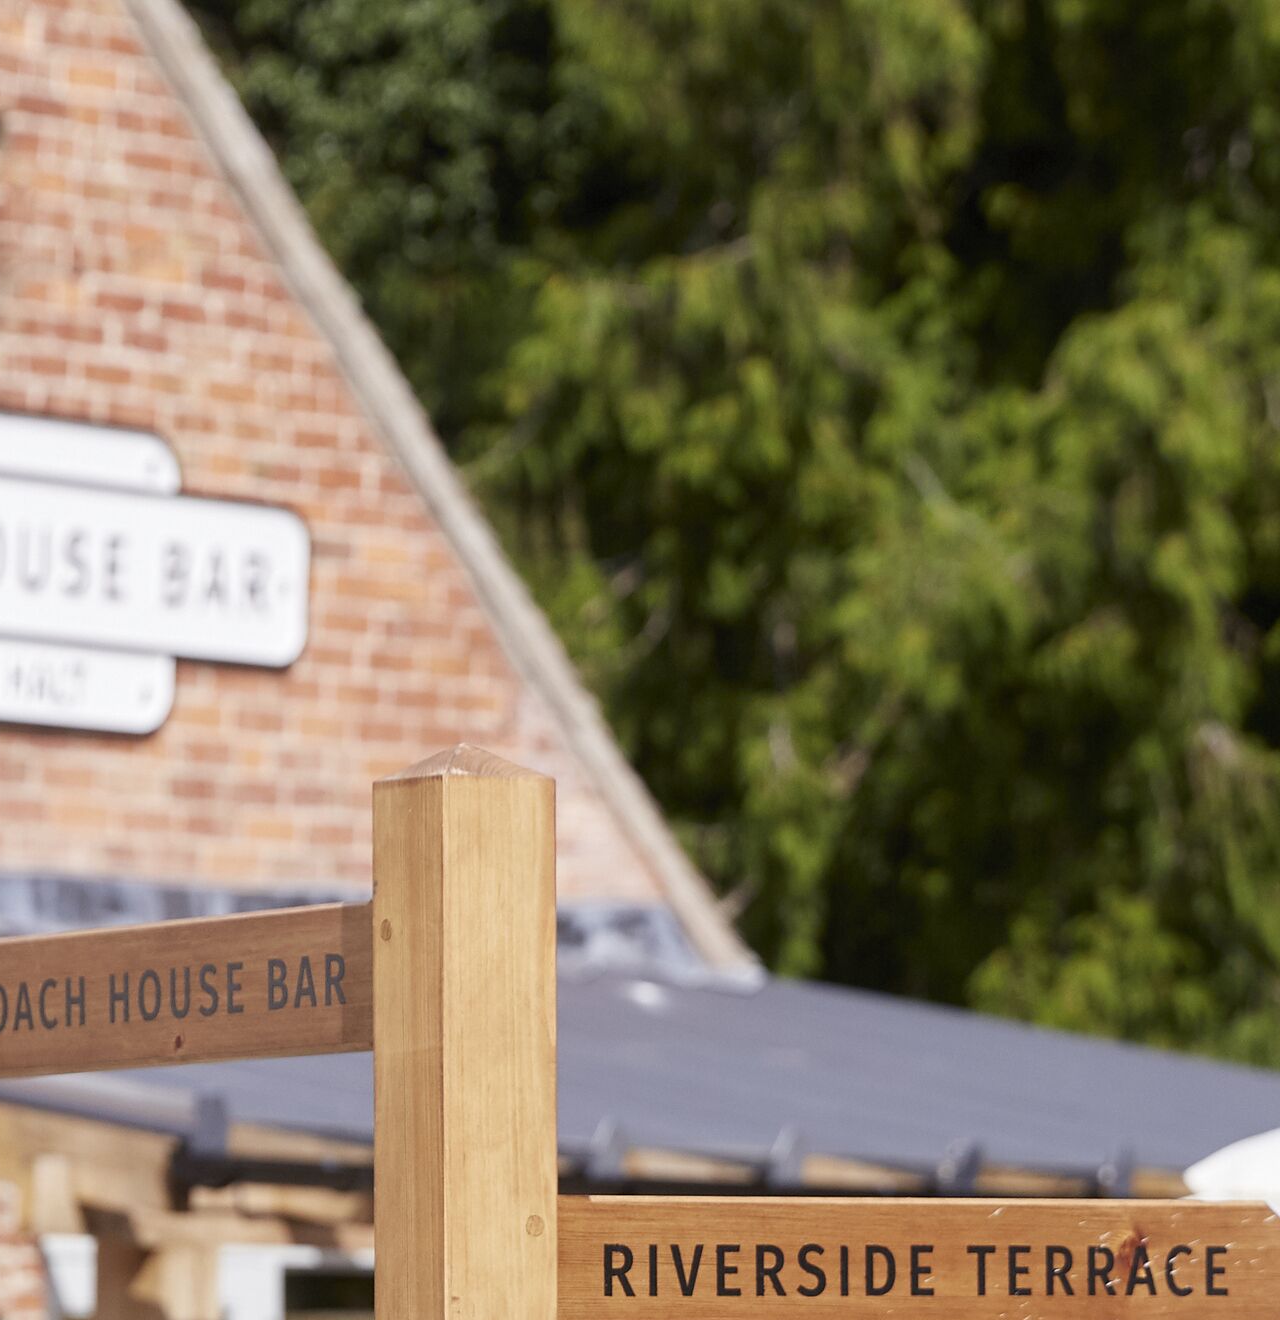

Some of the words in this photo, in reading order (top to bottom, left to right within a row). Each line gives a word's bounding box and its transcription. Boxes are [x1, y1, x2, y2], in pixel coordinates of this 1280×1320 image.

[159, 540, 274, 615] BAR
[108, 962, 244, 1024] HOUSE
[267, 954, 347, 1012] BAR
[603, 1243, 936, 1298] RIVERSIDE
[966, 1244, 1230, 1298] TERRACE
